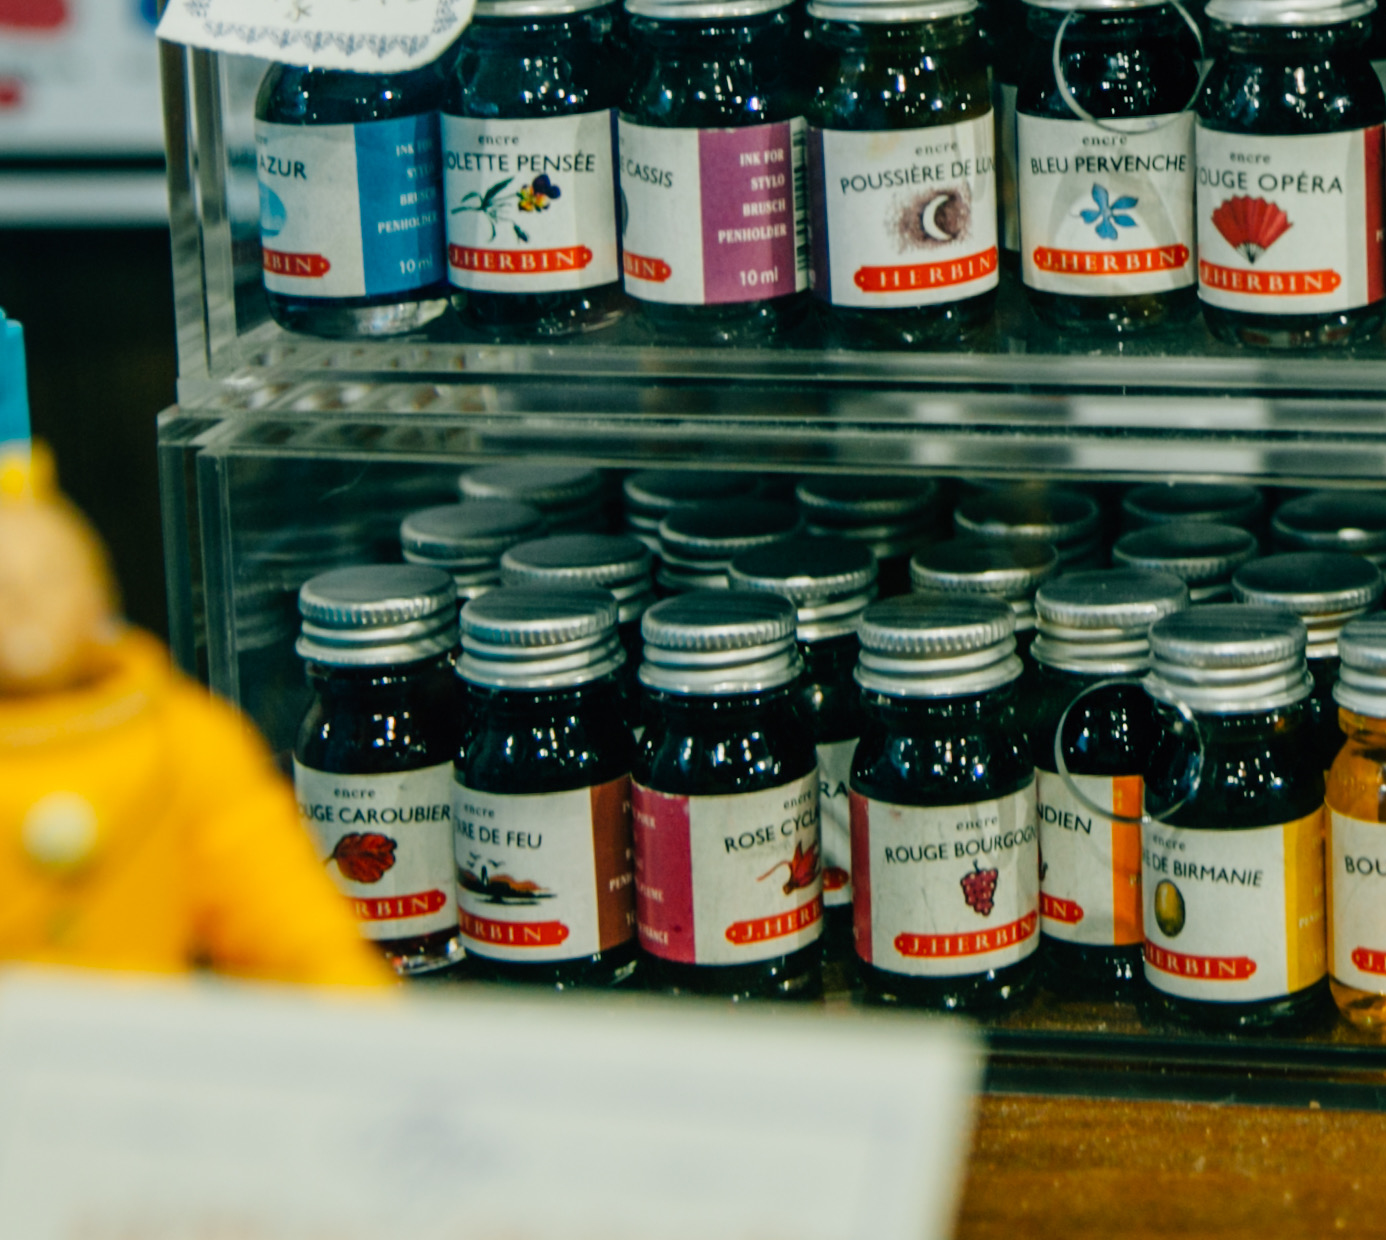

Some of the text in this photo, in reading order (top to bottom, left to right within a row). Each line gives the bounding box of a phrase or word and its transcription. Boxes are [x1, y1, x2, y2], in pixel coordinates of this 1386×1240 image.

[478, 134, 520, 147] encre
[914, 142, 959, 157] encre
[1082, 134, 1128, 147] encre
[448, 153, 510, 174] OLETTE
[516, 152, 597, 175] PENSÉE
[739, 148, 785, 167] INK FOR
[1030, 154, 1188, 176] BLEU PERVENCHE
[1229, 151, 1271, 165] encre
[258, 158, 308, 181] AZUR
[626, 164, 675, 189] CASSIS
[839, 153, 996, 195] POUSSIÈRE DE LUN
[750, 173, 786, 191] STYLO
[1200, 167, 1344, 195] OUGE OPÉRA
[742, 198, 787, 217] BRUSCH
[717, 223, 788, 245] PENHOLDER
[399, 258, 416, 276] 10
[451, 249, 576, 271] J.HERBIN
[1042, 248, 1176, 272] J.HERBIN
[739, 266, 779, 287] 10 ml
[879, 255, 992, 288] HERBIN
[333, 786, 377, 801] encre
[819, 780, 850, 800] RA
[338, 802, 451, 825] CAROUBIER
[956, 815, 999, 832] encre
[479, 825, 501, 846] DE
[506, 831, 543, 850] FEU
[724, 825, 776, 854] ROSE
[884, 827, 1037, 865] ROUGE BOURGOGN
[1151, 853, 1169, 874] DE
[1172, 859, 1264, 888] BIRMANIE
